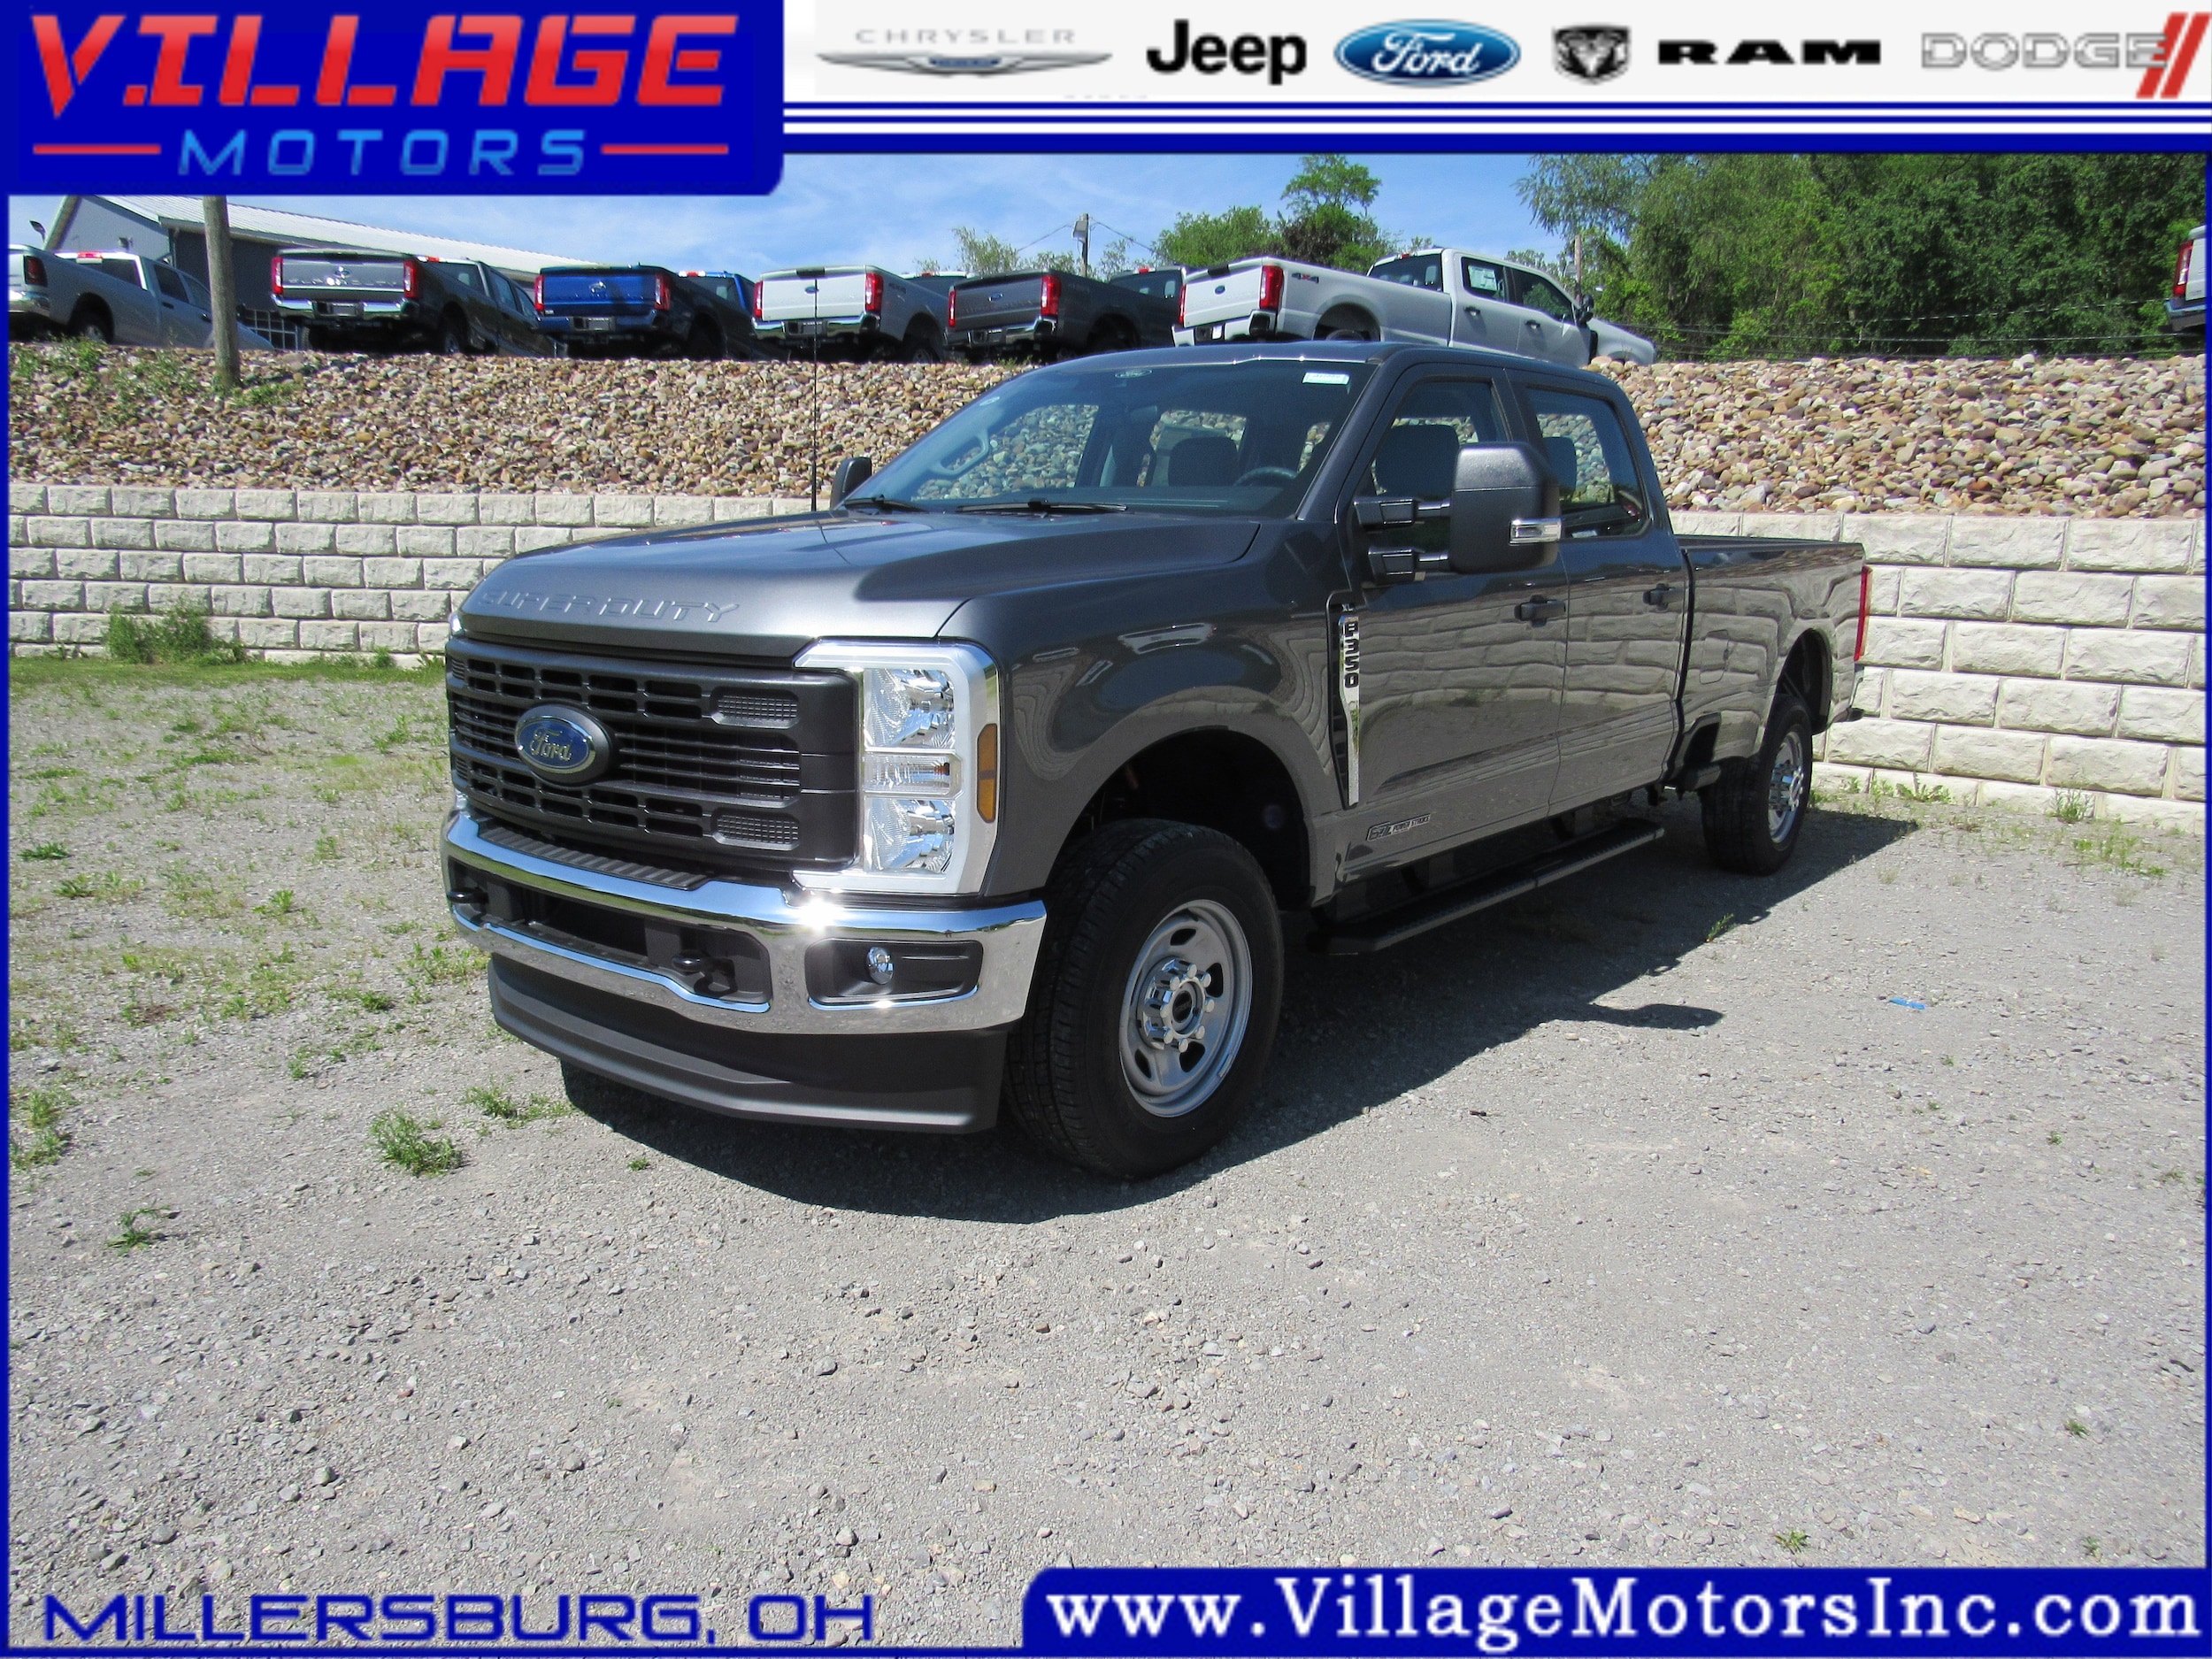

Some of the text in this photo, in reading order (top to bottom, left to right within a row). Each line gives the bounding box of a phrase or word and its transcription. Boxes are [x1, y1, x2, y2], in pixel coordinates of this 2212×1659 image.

[480, 591, 740, 623] SUPER DUTY
[530, 726, 572, 762] Ford
